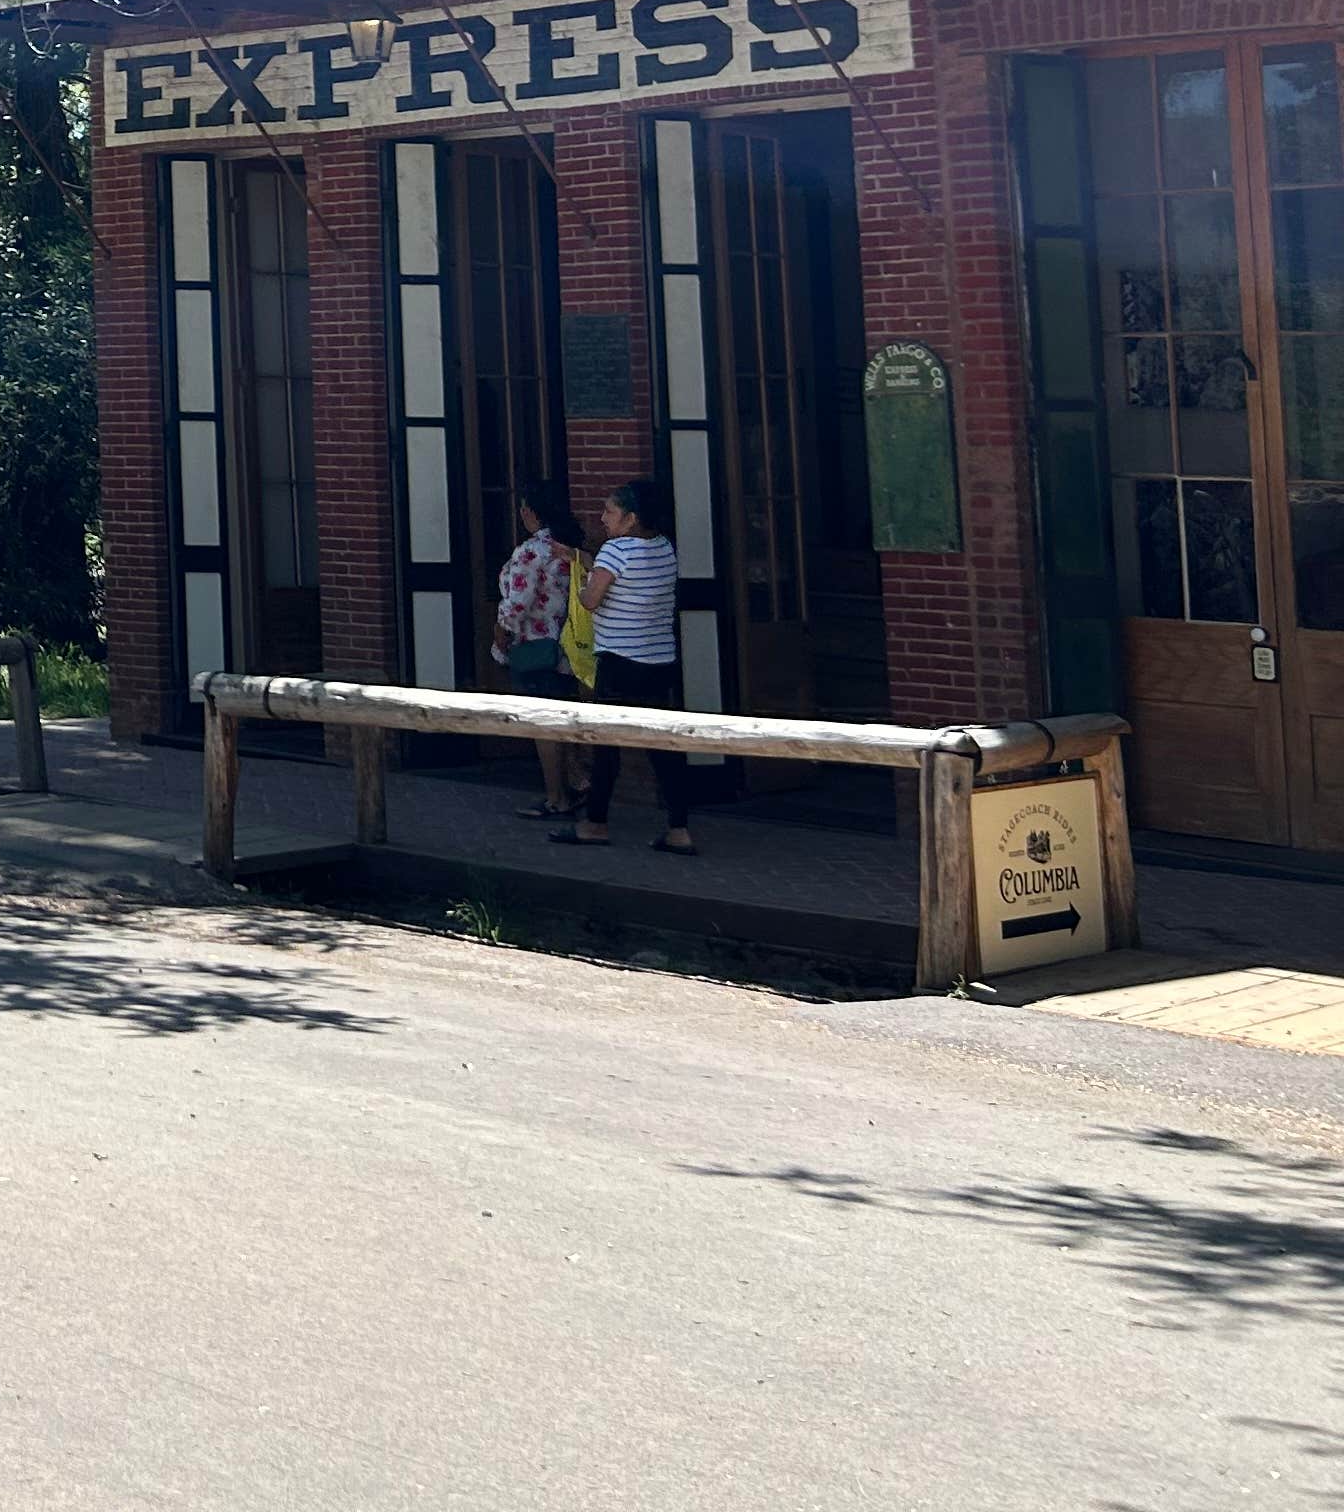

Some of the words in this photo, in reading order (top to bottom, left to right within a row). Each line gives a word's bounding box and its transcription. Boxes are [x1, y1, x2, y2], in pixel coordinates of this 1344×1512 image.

[864, 352, 886, 392] WELLS
[997, 803, 1052, 854] STAGECOACH
[1052, 809, 1078, 845] RIDES
